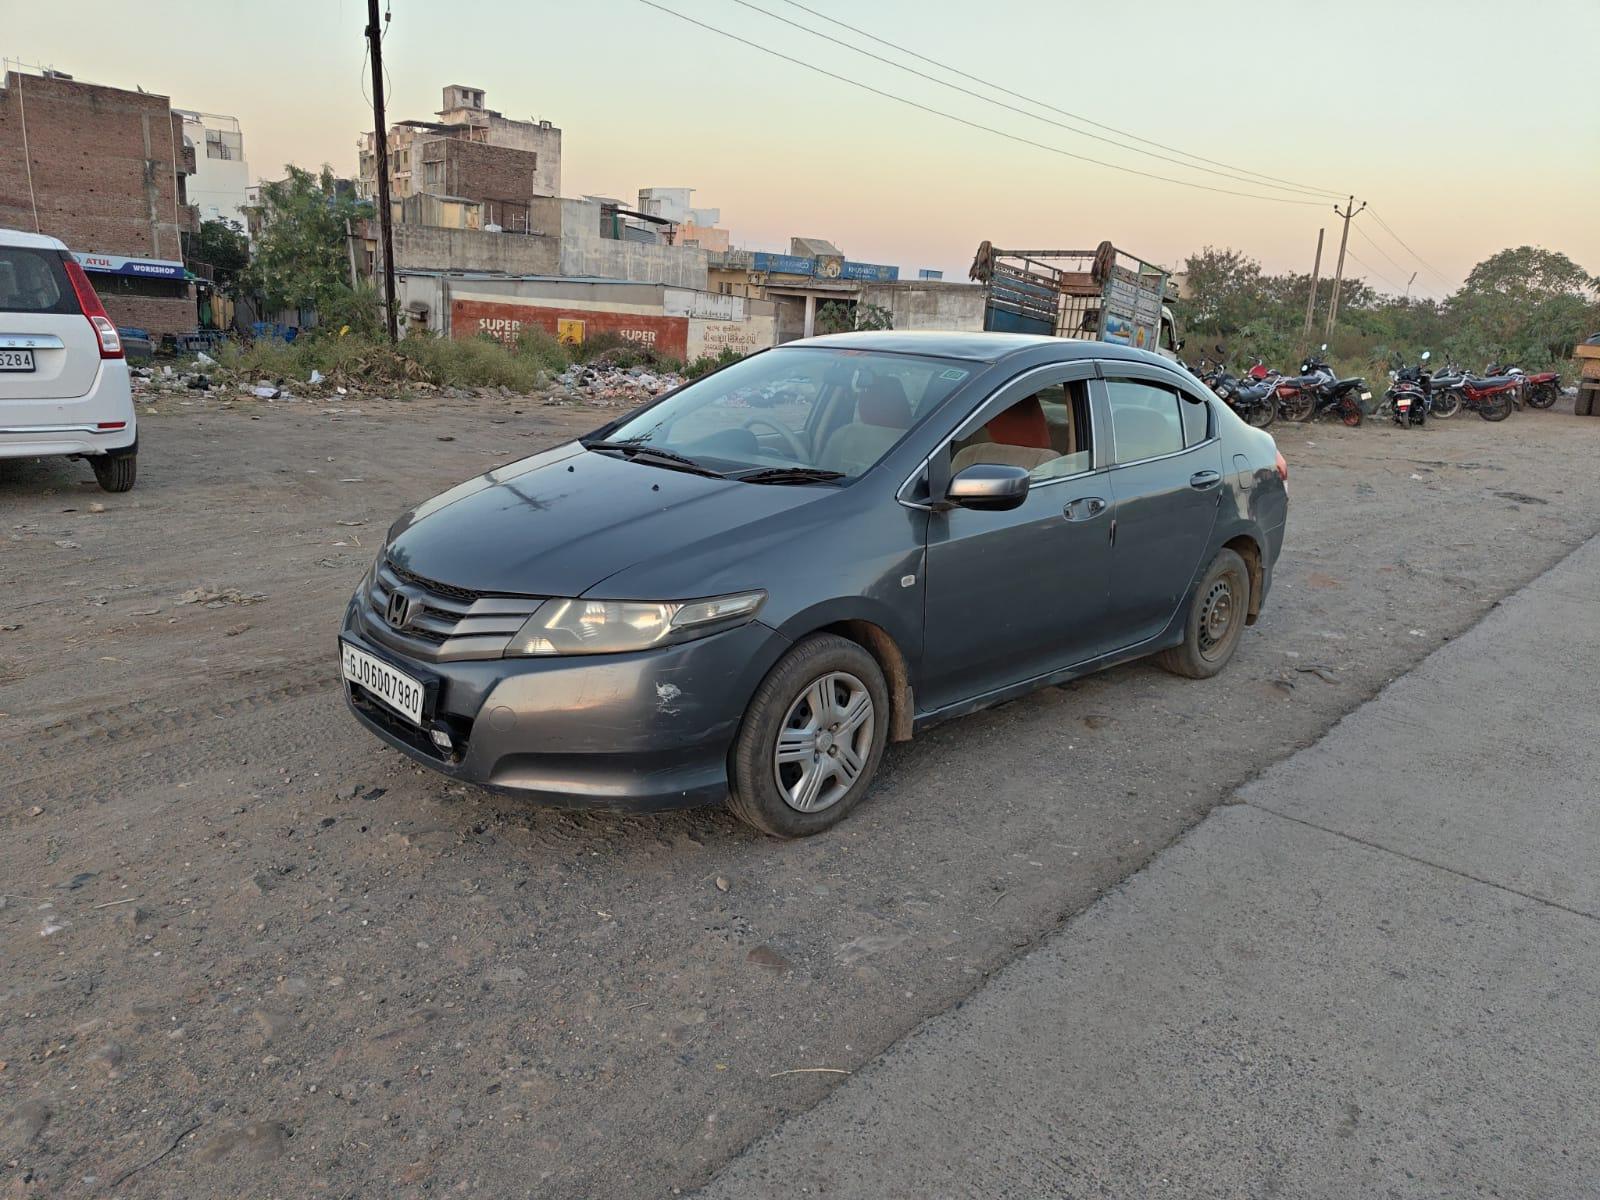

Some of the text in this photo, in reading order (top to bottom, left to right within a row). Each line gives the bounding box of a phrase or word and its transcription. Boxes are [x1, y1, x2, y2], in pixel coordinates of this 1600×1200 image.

[86, 257, 112, 267] ATUL
[132, 264, 175, 275] WORKSHOP
[479, 318, 521, 331] SUPER
[620, 329, 656, 342] SUPER
